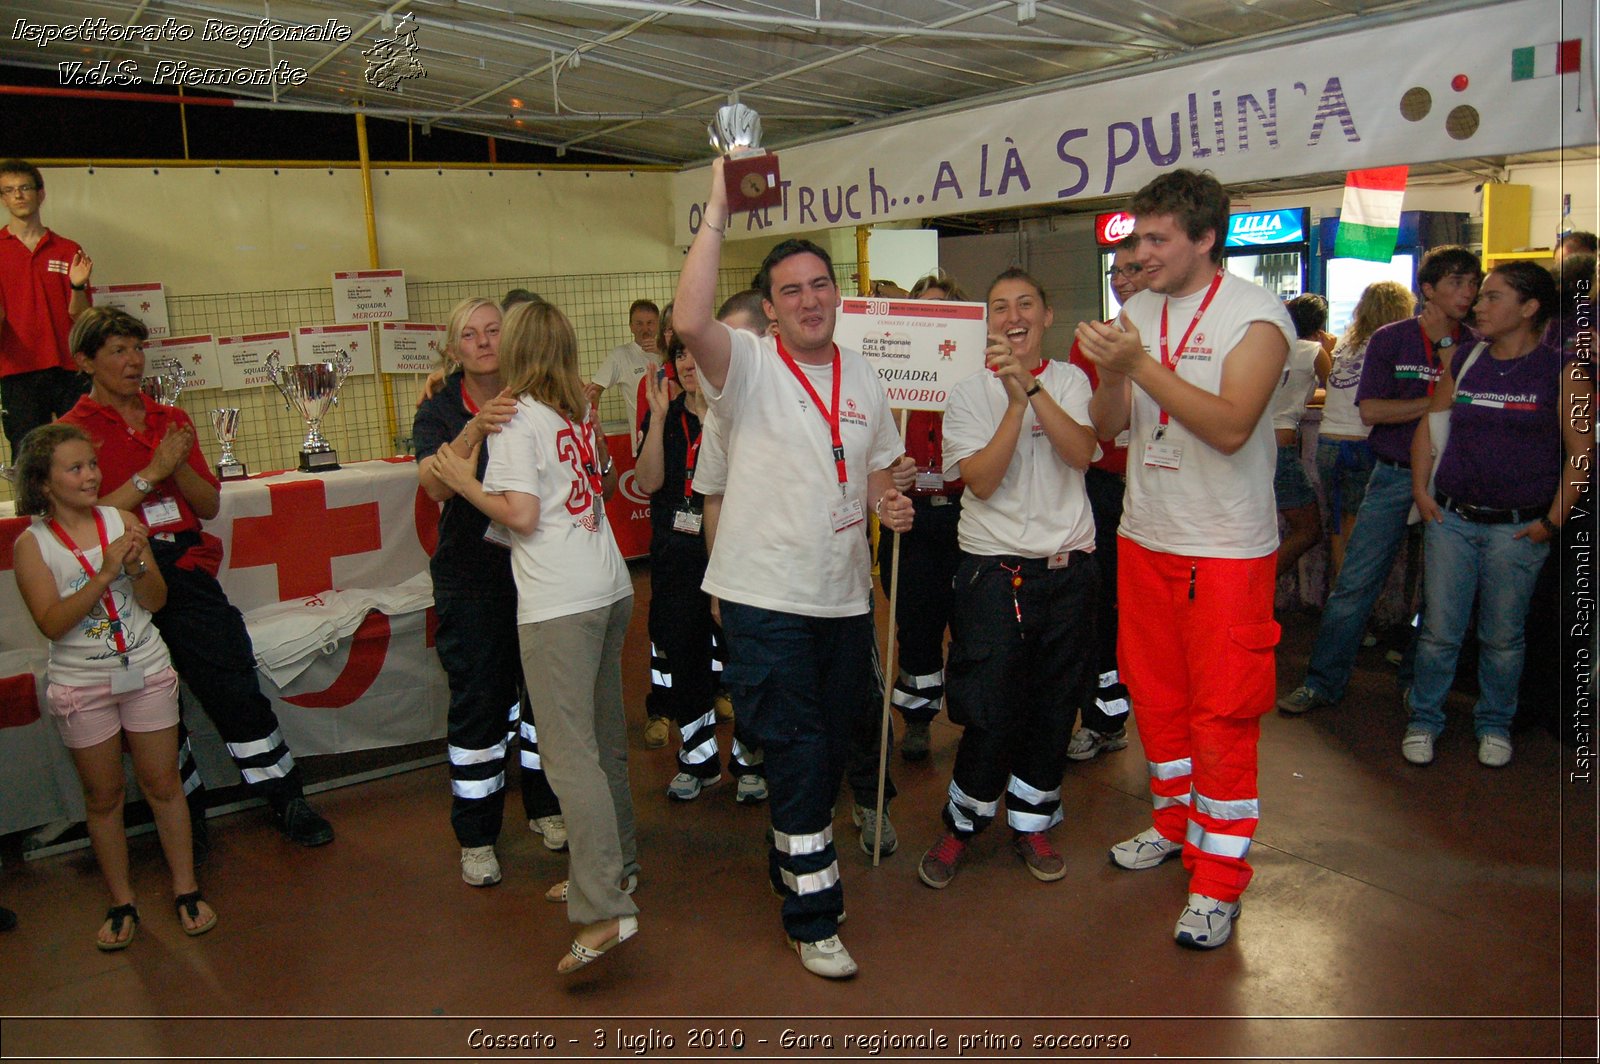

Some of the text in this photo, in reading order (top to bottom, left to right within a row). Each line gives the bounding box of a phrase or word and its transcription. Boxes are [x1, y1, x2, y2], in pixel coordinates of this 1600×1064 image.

[932, 160, 963, 201] A
[1232, 214, 1282, 233] LILIA
[356, 302, 387, 310] SQUADRA
[352, 311, 393, 319] MERGOZZO
[880, 338, 911, 346] Regionale
[878, 368, 938, 382] SQUADRA
[886, 388, 947, 402] NNOBIO
